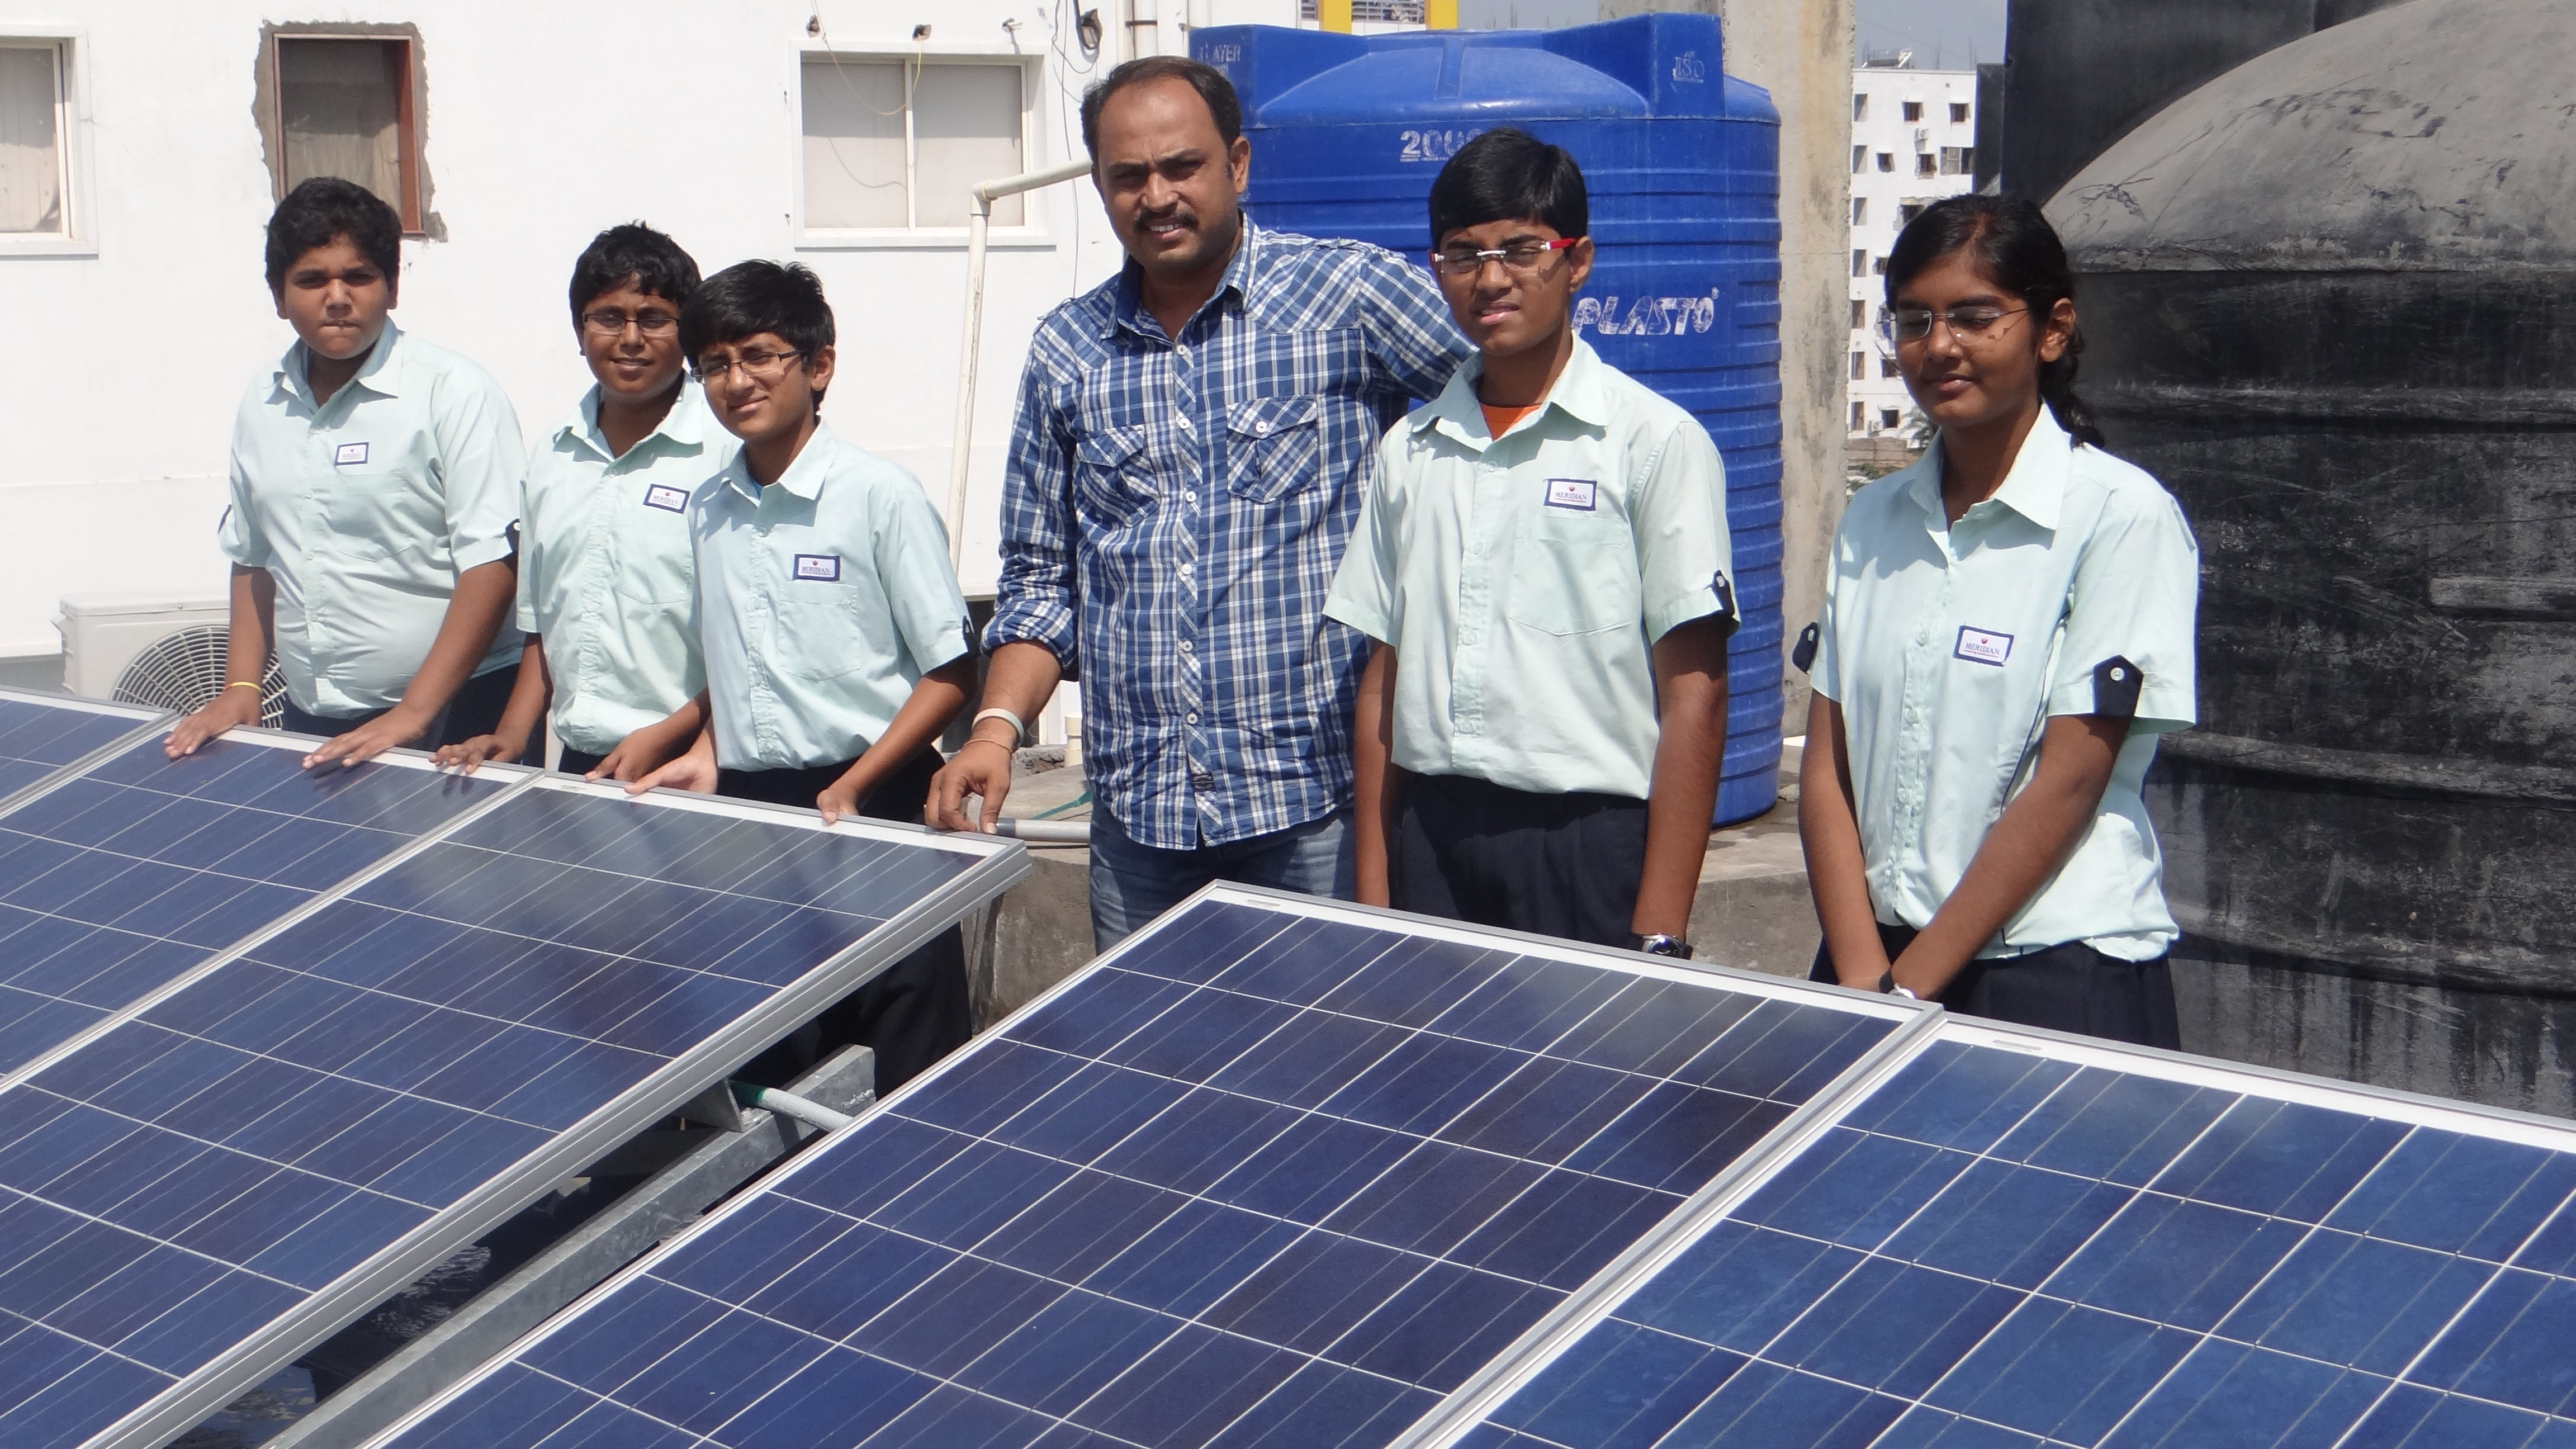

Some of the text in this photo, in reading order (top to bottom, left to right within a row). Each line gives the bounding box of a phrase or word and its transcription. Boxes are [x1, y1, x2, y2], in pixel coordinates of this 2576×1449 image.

[1571, 296, 1714, 335] PLASTO
[1555, 491, 1587, 500] MERIDIAN
[1965, 642, 2000, 655] MERIDIAN
